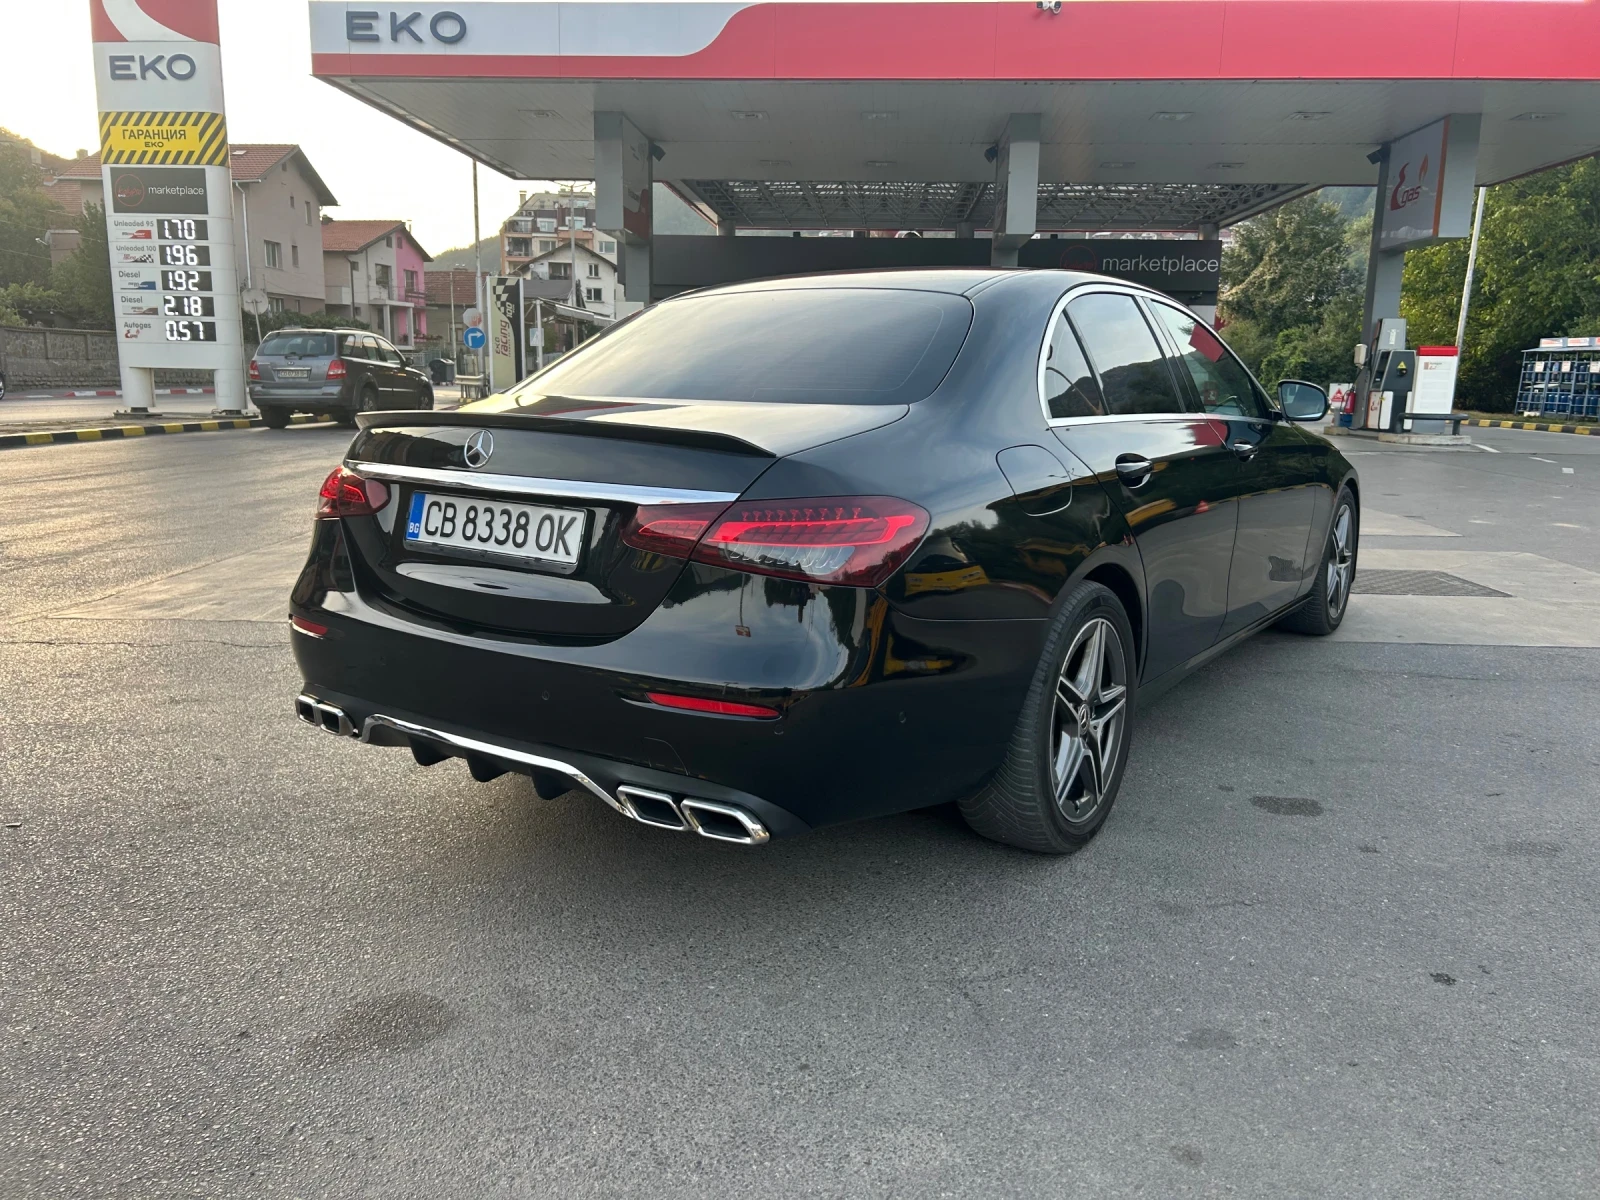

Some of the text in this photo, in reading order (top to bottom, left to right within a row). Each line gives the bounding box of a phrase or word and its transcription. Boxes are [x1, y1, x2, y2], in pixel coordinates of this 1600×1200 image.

[346, 10, 467, 43] EKO
[109, 54, 196, 80] EKO
[122, 129, 187, 141] ГАРАНЦИЯ
[148, 185, 204, 196] marketplace
[1102, 254, 1219, 276] marketplace
[118, 270, 141, 278] Diesel
[121, 295, 143, 303] Diesel
[164, 295, 202, 317] 2.18
[124, 321, 151, 330] Autogas
[500, 320, 510, 356] racing
[408, 522, 420, 534] BG
[424, 501, 577, 556] CB 8338 OK
